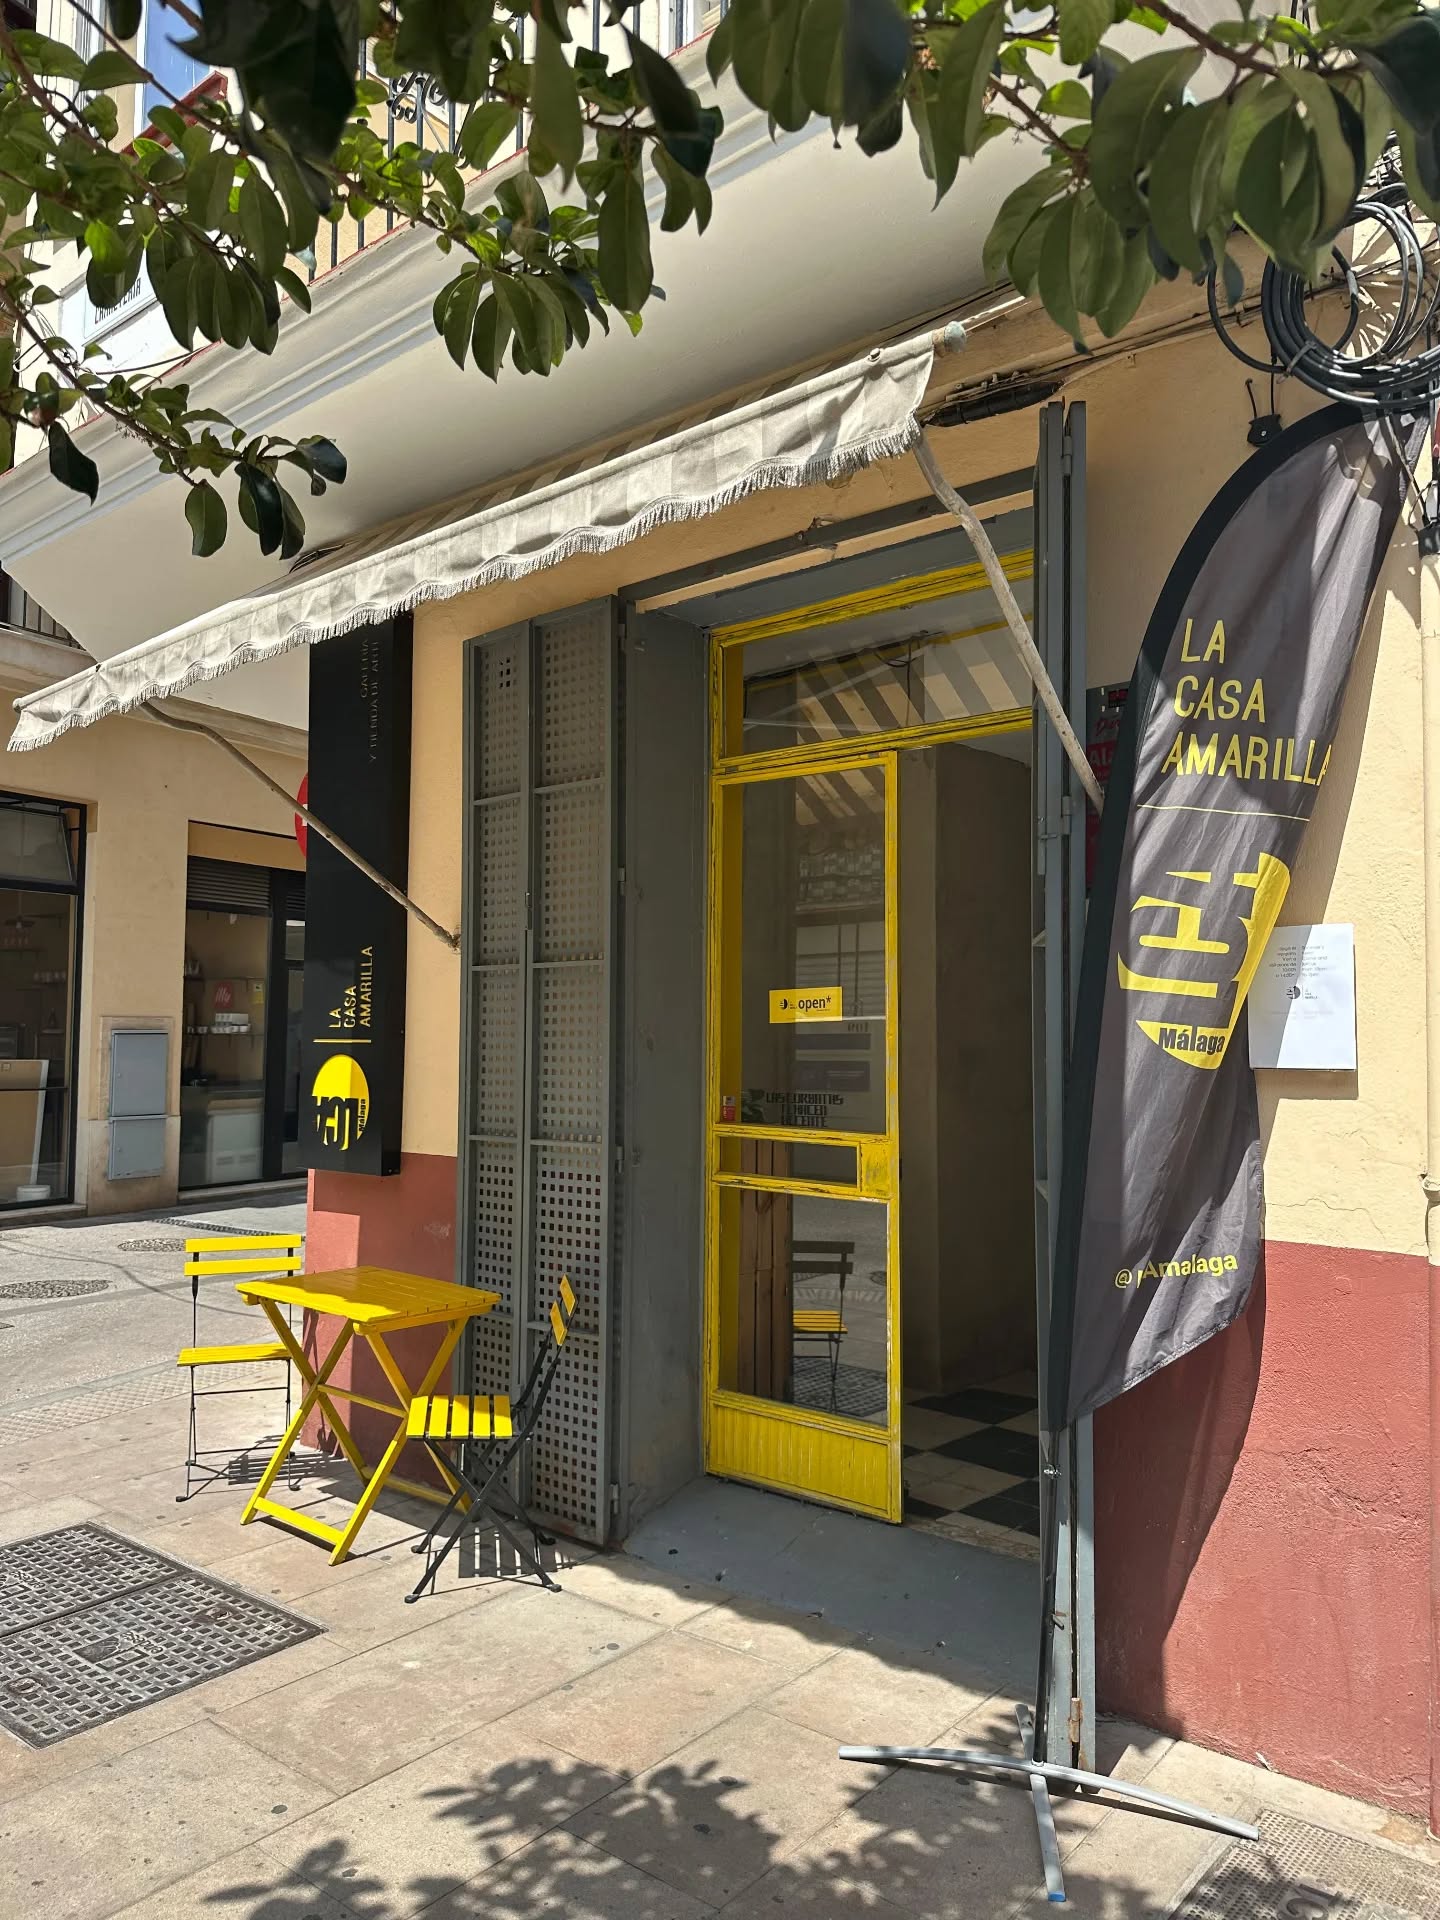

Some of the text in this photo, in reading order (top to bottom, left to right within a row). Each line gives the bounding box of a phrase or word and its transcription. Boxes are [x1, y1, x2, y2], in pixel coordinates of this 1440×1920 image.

[1181, 618, 1226, 664] LA
[1173, 675, 1266, 723] CASA
[1161, 731, 1331, 786] AMARILLA
[343, 985, 357, 1028] CASA
[359, 946, 373, 1027] AMARILLA
[328, 1007, 342, 1028] LA
[1158, 1027, 1226, 1056] Málaga
